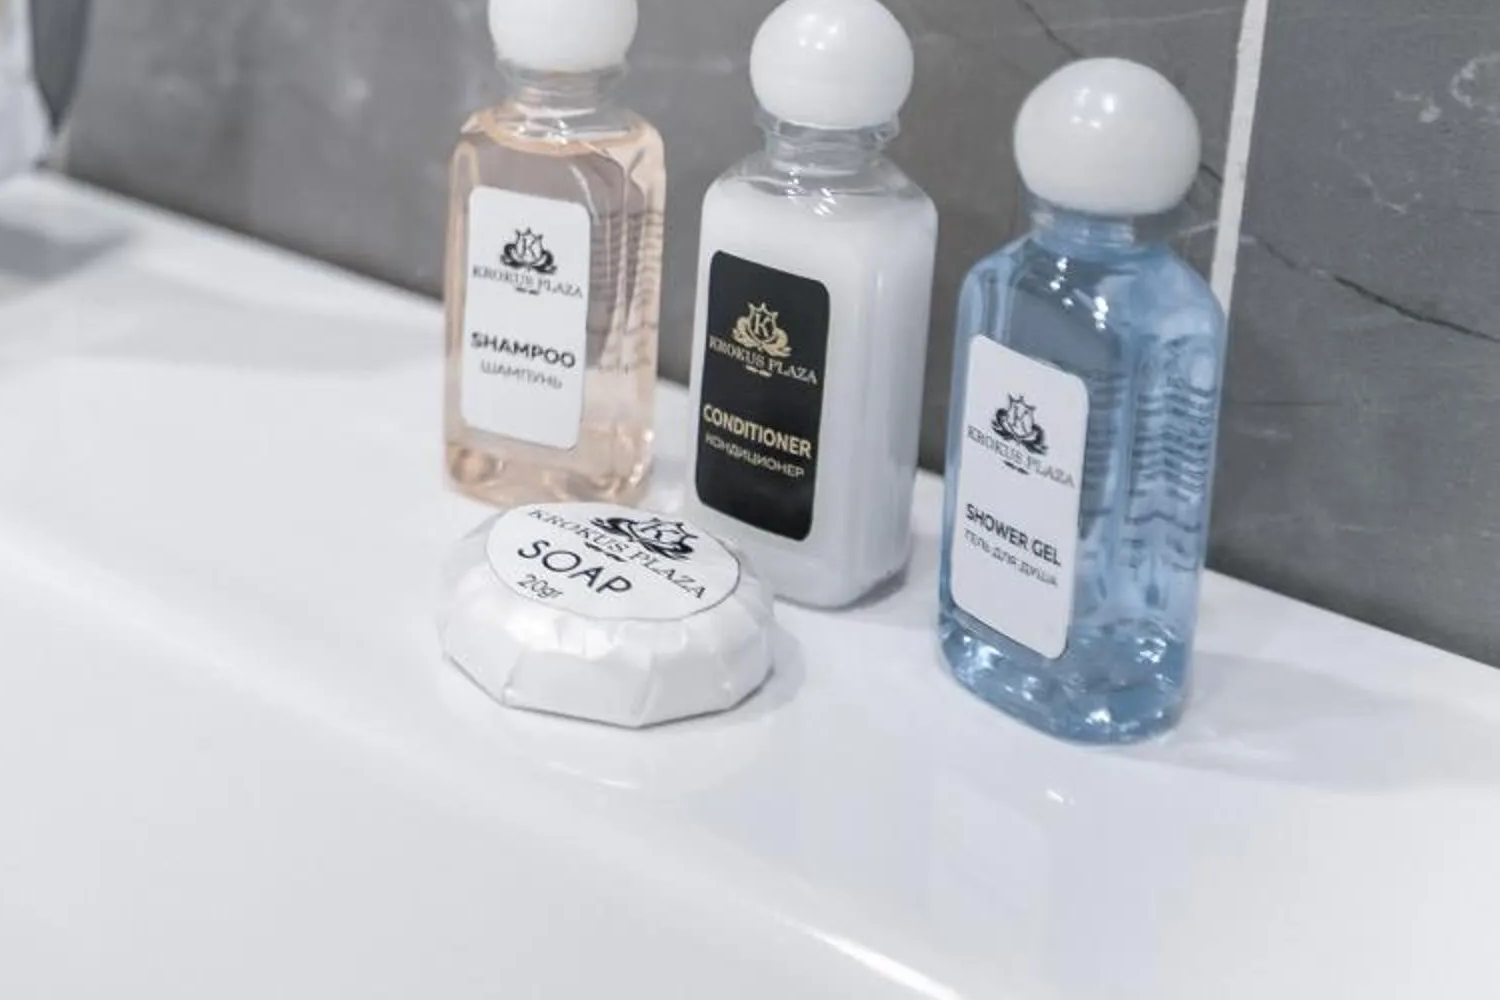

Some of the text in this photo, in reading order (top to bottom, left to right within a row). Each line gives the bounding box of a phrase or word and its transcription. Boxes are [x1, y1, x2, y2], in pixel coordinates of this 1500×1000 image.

[473, 265, 582, 298] KROKUS PLAZA
[471, 332, 576, 368] SHAMPOO
[481, 359, 562, 389] ШАМПУНЬ
[709, 335, 817, 384] KROKUS PLAZA
[703, 403, 812, 458] CONDITIONER
[706, 434, 804, 477] КОНДИЦИОНЕР
[968, 425, 1074, 488] KROKUS PLAZA
[528, 509, 706, 599] KROKUS PLAZA
[966, 503, 1061, 566] SHOWER GEL
[518, 540, 632, 592] SOAP
